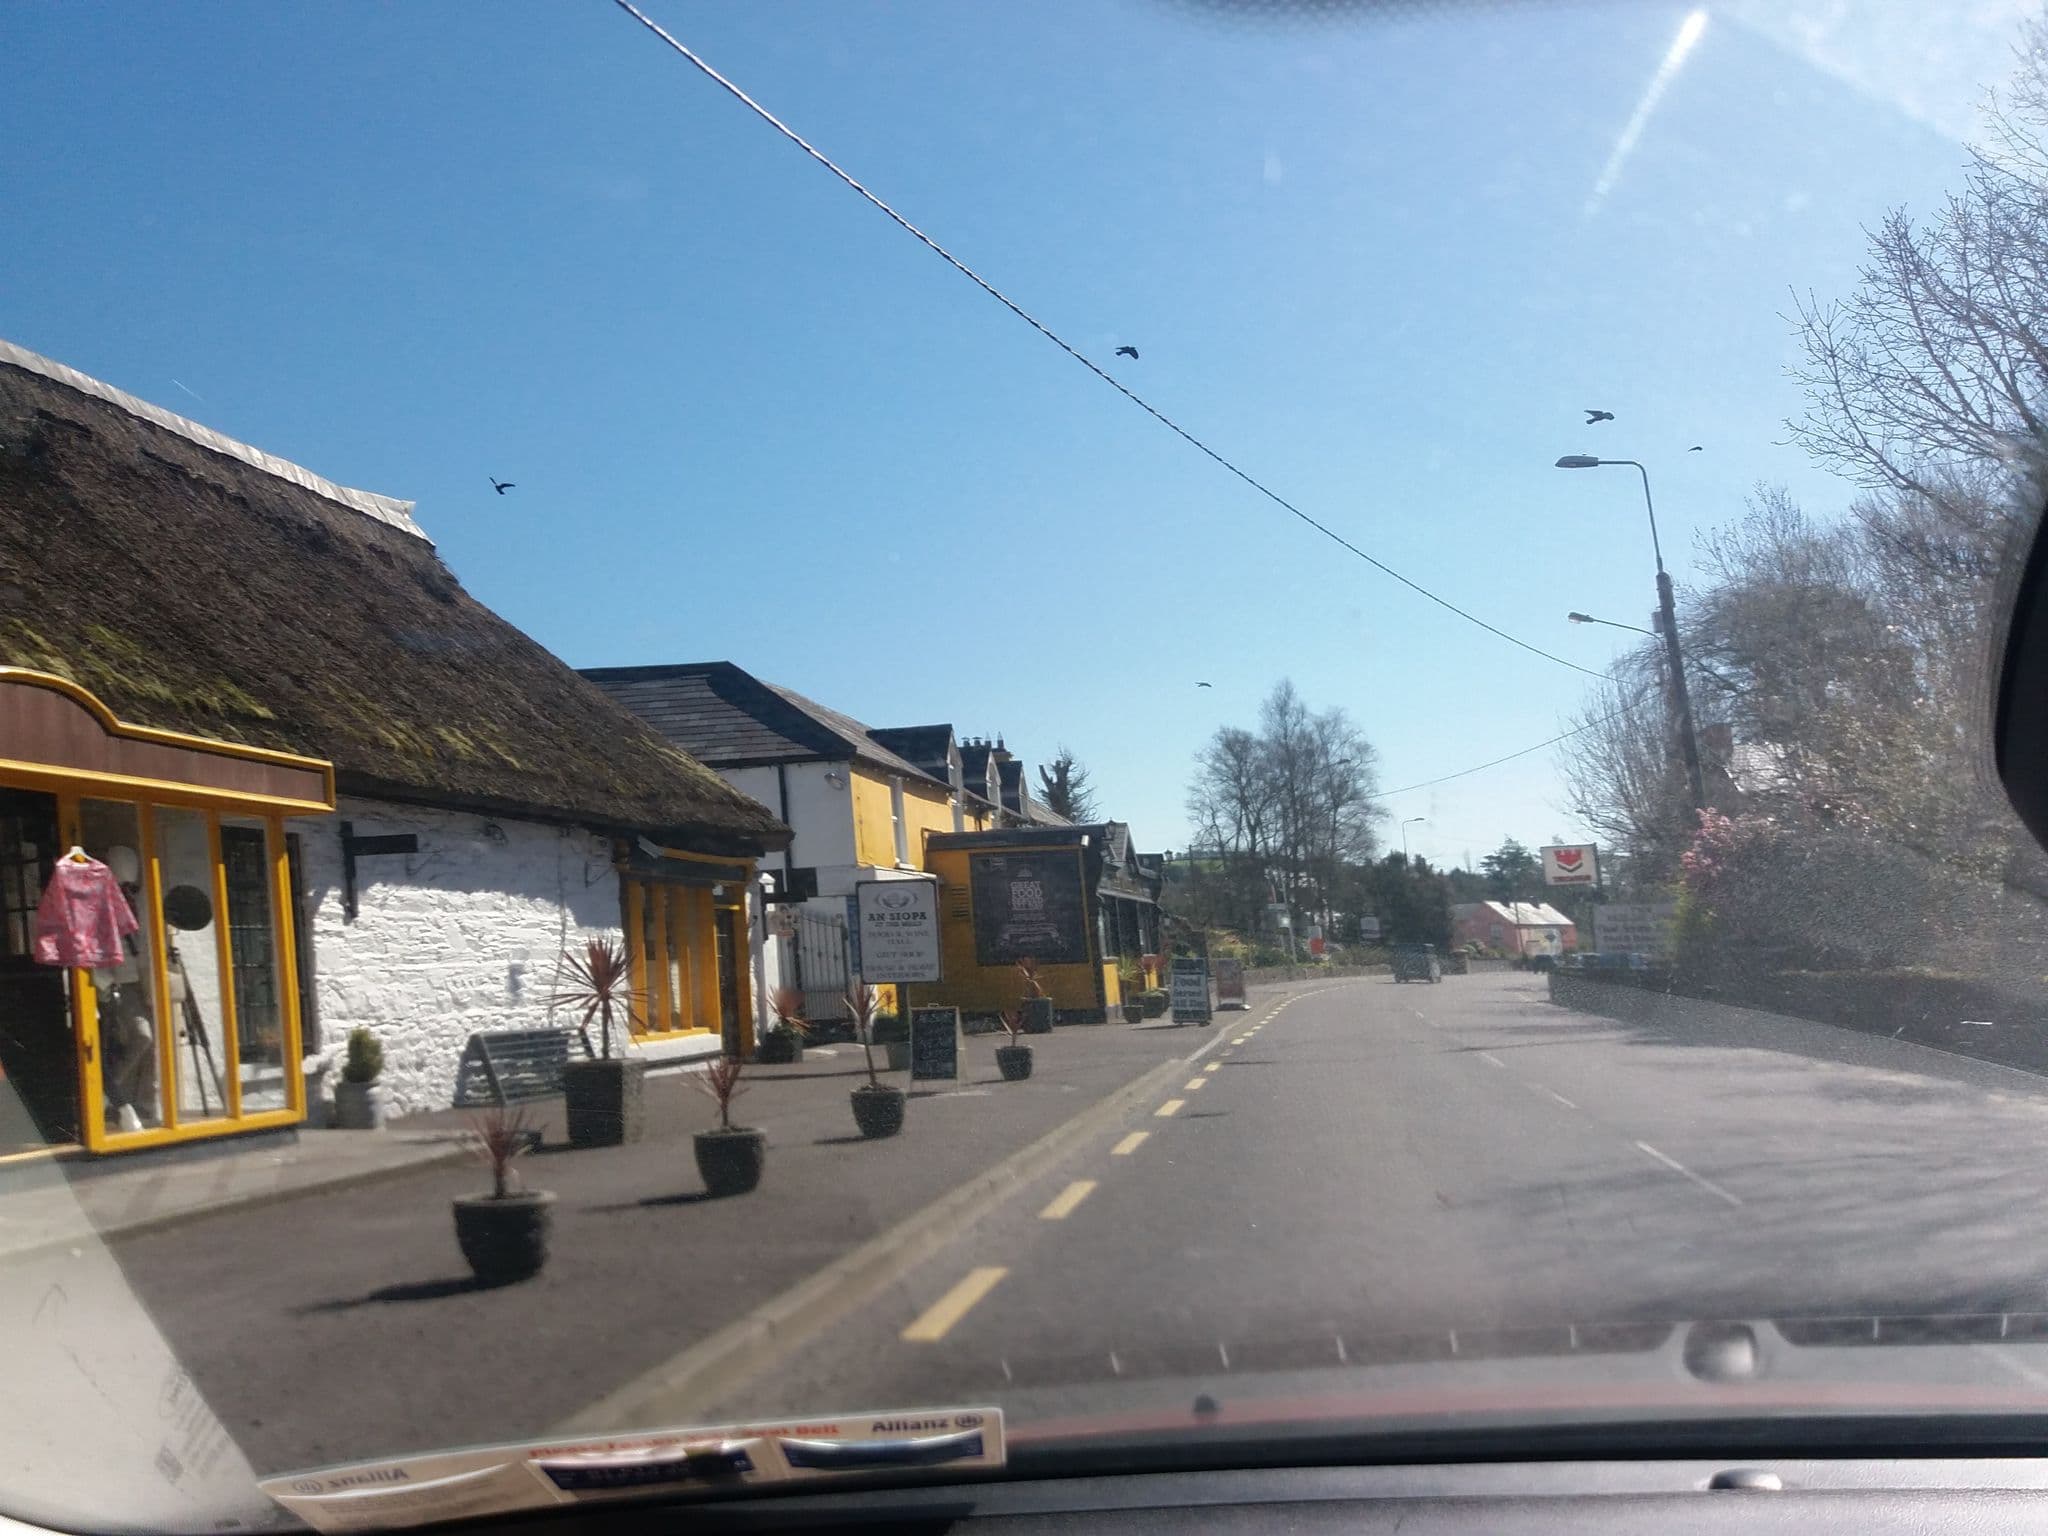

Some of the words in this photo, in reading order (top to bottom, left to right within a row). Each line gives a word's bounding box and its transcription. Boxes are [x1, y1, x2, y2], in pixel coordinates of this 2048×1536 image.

[1011, 888, 1043, 898] FOOD
[867, 913, 885, 922] AN
[889, 912, 927, 921] SIOPA
[795, 1423, 841, 1436] Belt
[871, 1417, 950, 1433] Allianz
